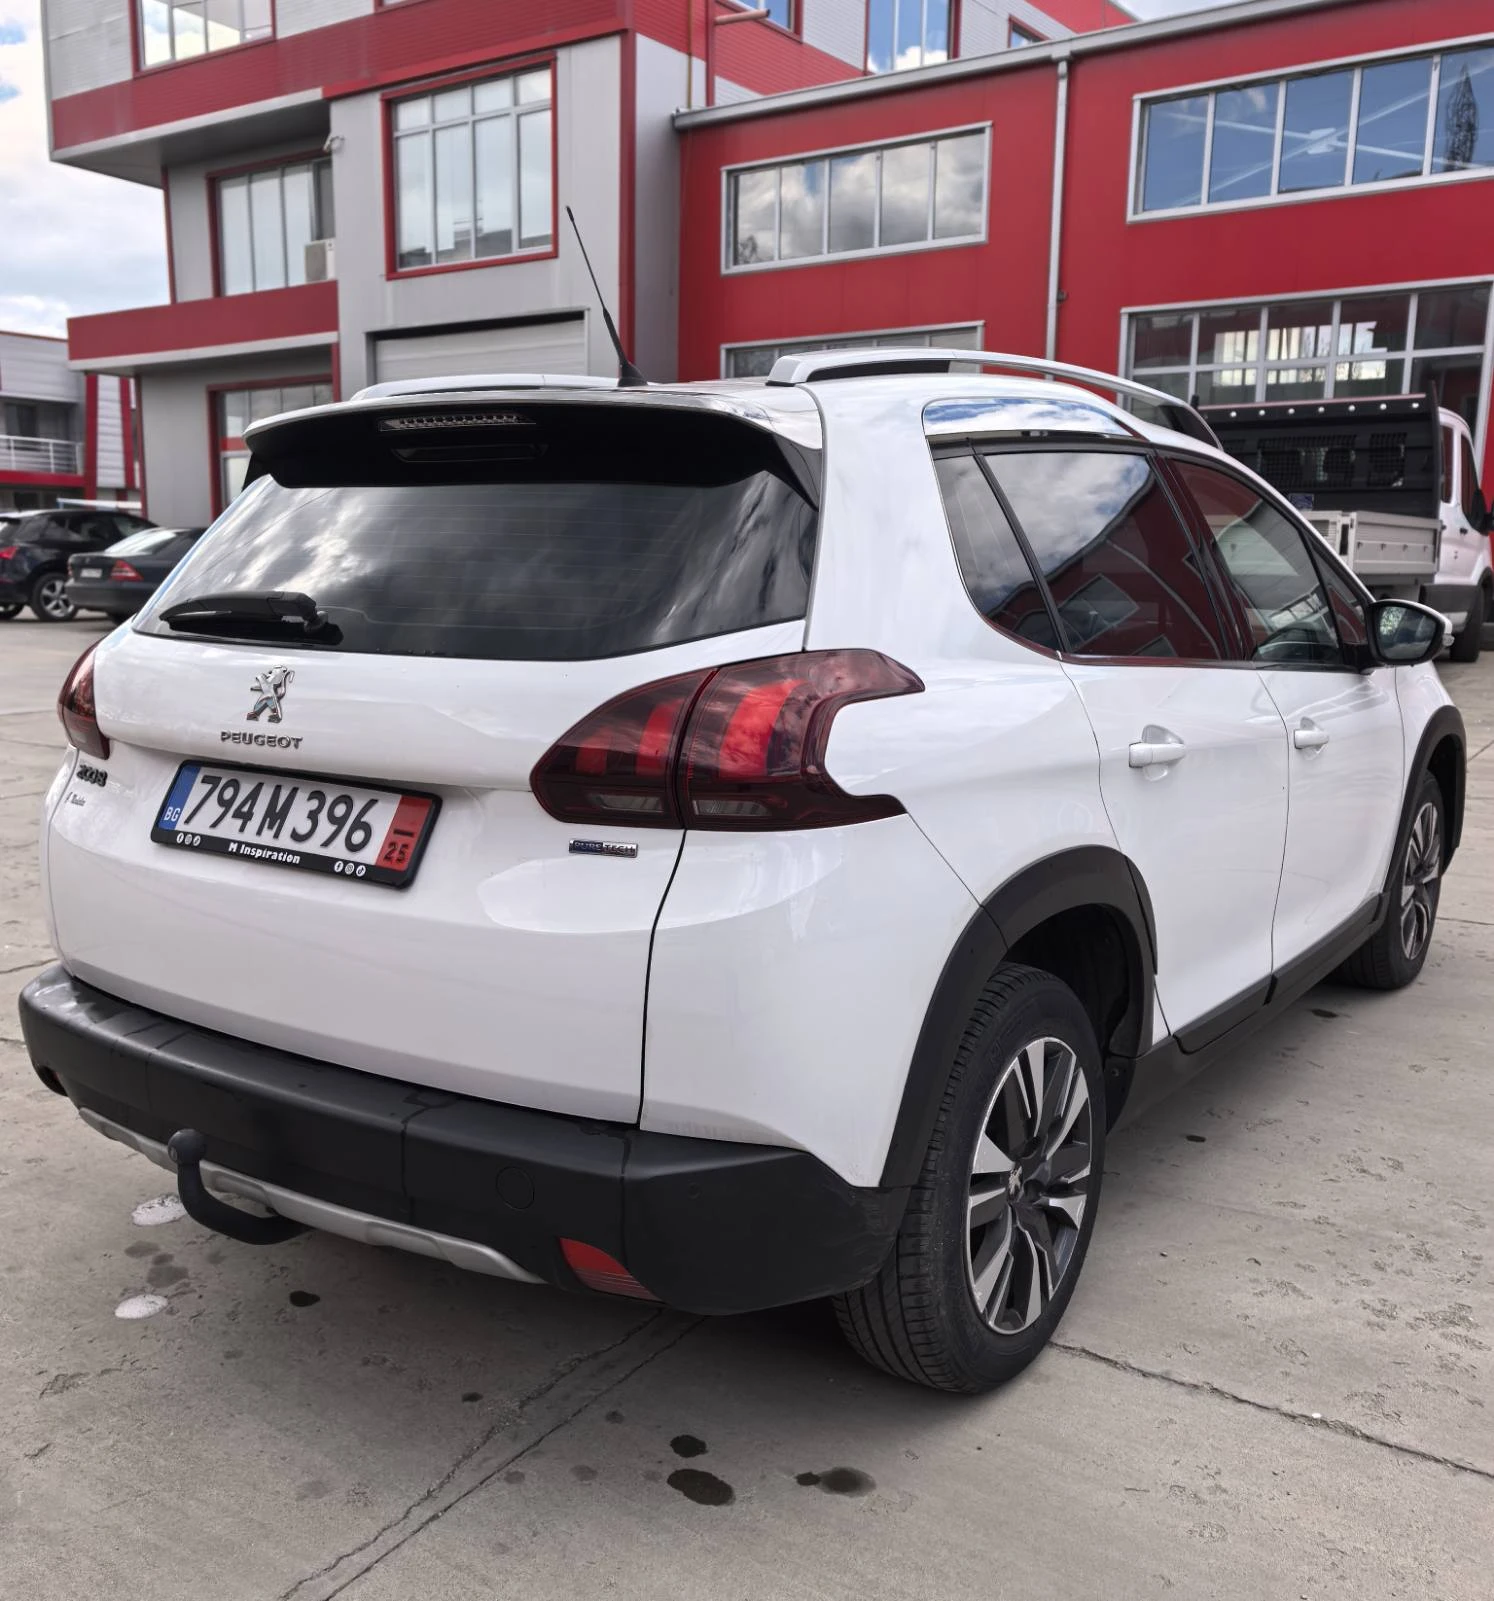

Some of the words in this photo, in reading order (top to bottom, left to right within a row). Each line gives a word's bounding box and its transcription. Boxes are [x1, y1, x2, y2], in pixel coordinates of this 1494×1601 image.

[220, 731, 303, 749] PEUGEOT
[163, 806, 180, 822] BG
[228, 841, 238, 852] M
[240, 844, 300, 865] Inspiration
[383, 841, 409, 864] 25
